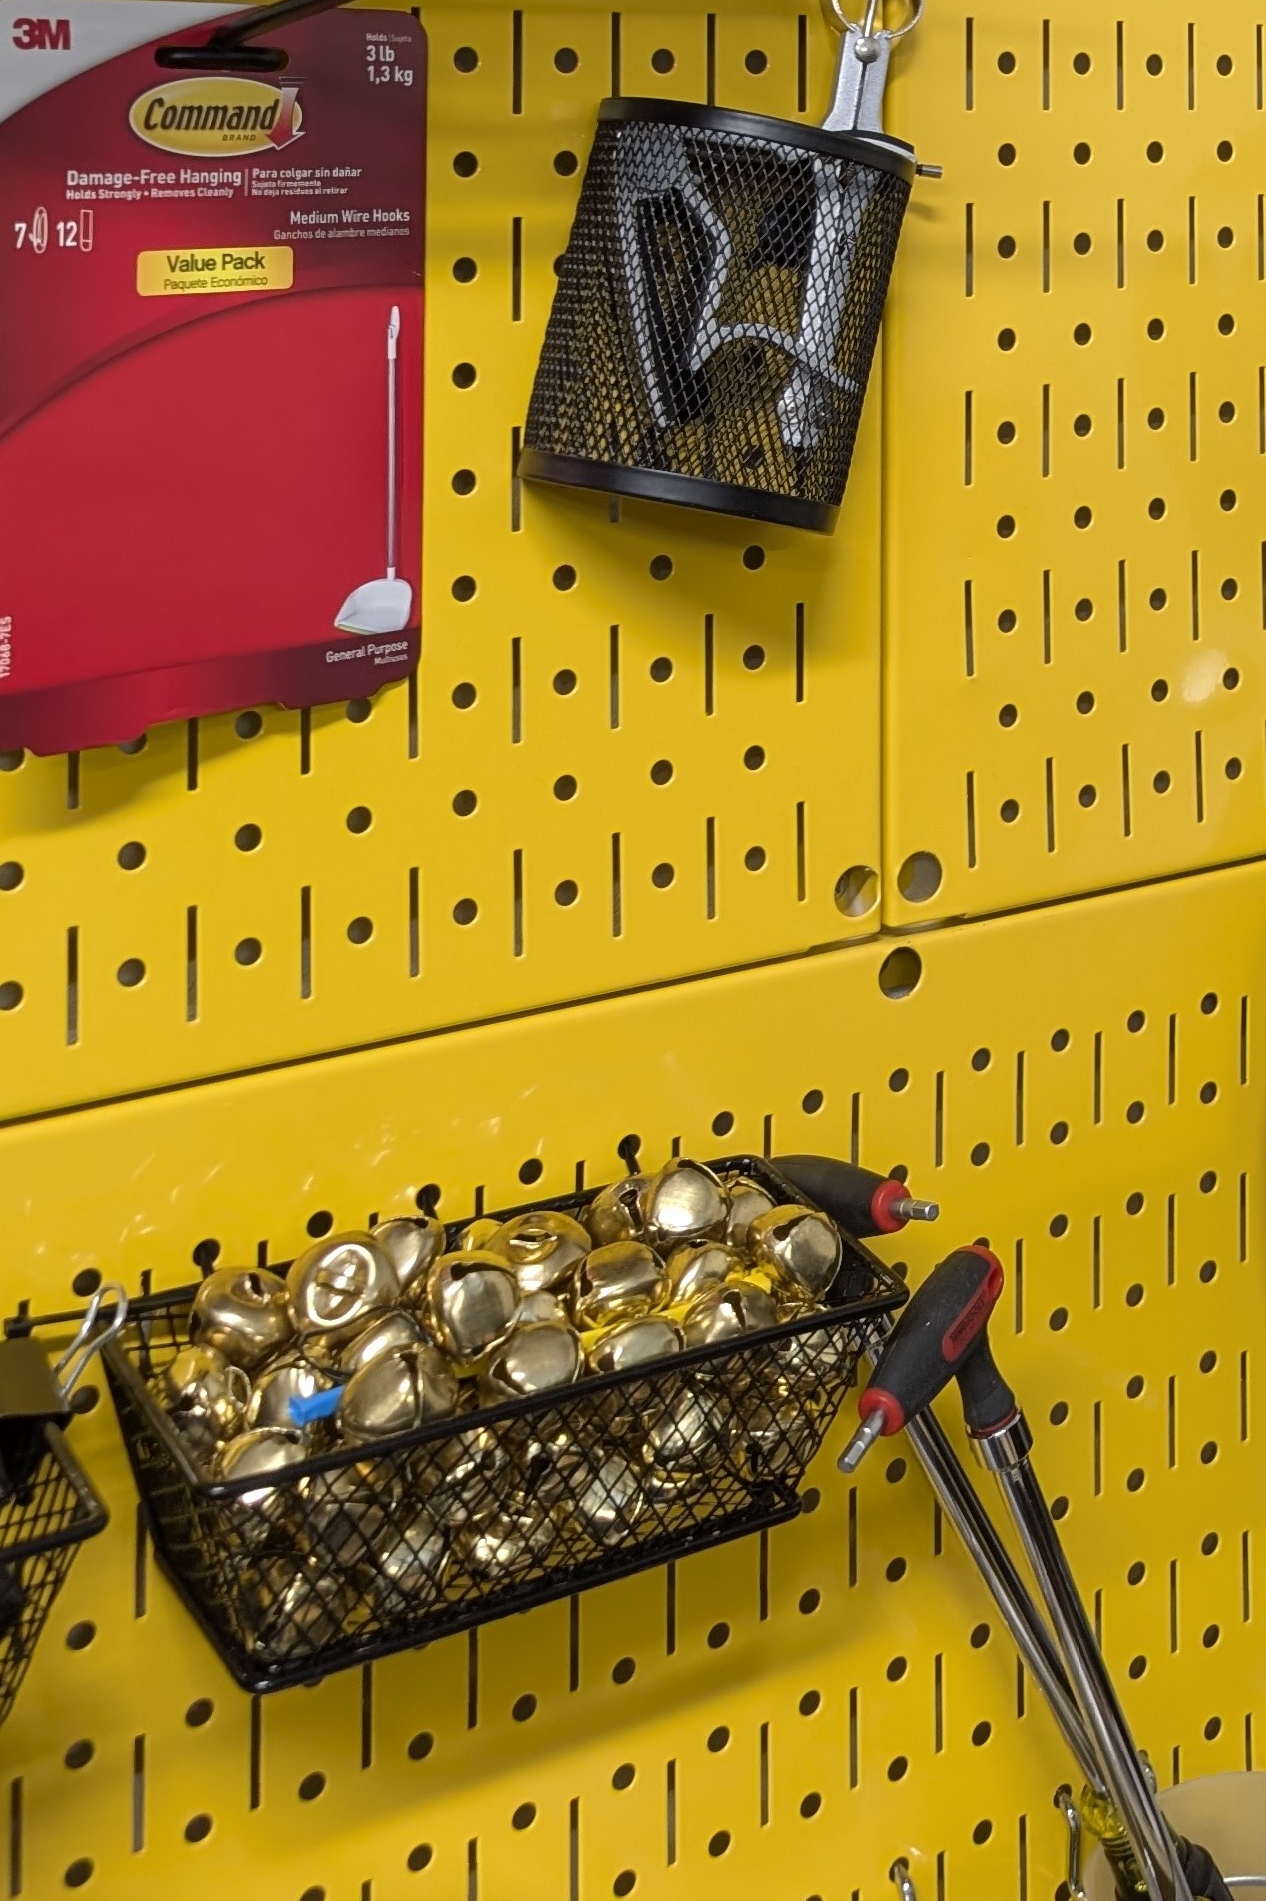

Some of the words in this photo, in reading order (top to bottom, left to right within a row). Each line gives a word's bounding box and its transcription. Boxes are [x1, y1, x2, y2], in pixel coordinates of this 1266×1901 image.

[12, 17, 71, 50] 3M
[366, 44, 376, 62] 3
[379, 45, 395, 62] lb
[367, 65, 390, 85] 1,3
[394, 65, 414, 87] kg
[144, 97, 281, 131] Command
[222, 134, 257, 142] BRAND
[66, 169, 176, 189] Damage-Free
[179, 168, 242, 187] Hanging
[252, 168, 278, 179] Para
[279, 167, 314, 180] colgar
[315, 167, 331, 178] sin
[332, 166, 363, 178] dañar
[66, 189, 97, 200] Holds
[98, 188, 142, 201] Strongly
[150, 187, 196, 199] Removes
[197, 186, 235, 199] Cleanly
[290, 210, 339, 225] Medium
[341, 209, 370, 223] Wire
[372, 208, 411, 223] Hooks
[14, 222, 27, 249] 7
[56, 221, 78, 247] 12
[273, 229, 314, 240] Ganchos
[314, 229, 327, 239] de
[166, 253, 217, 273] Value
[221, 251, 266, 271] Pack
[163, 278, 208, 292] Paquete
[210, 274, 268, 289] Económico
[325, 645, 366, 663] General
[367, 640, 409, 657] Purpose
